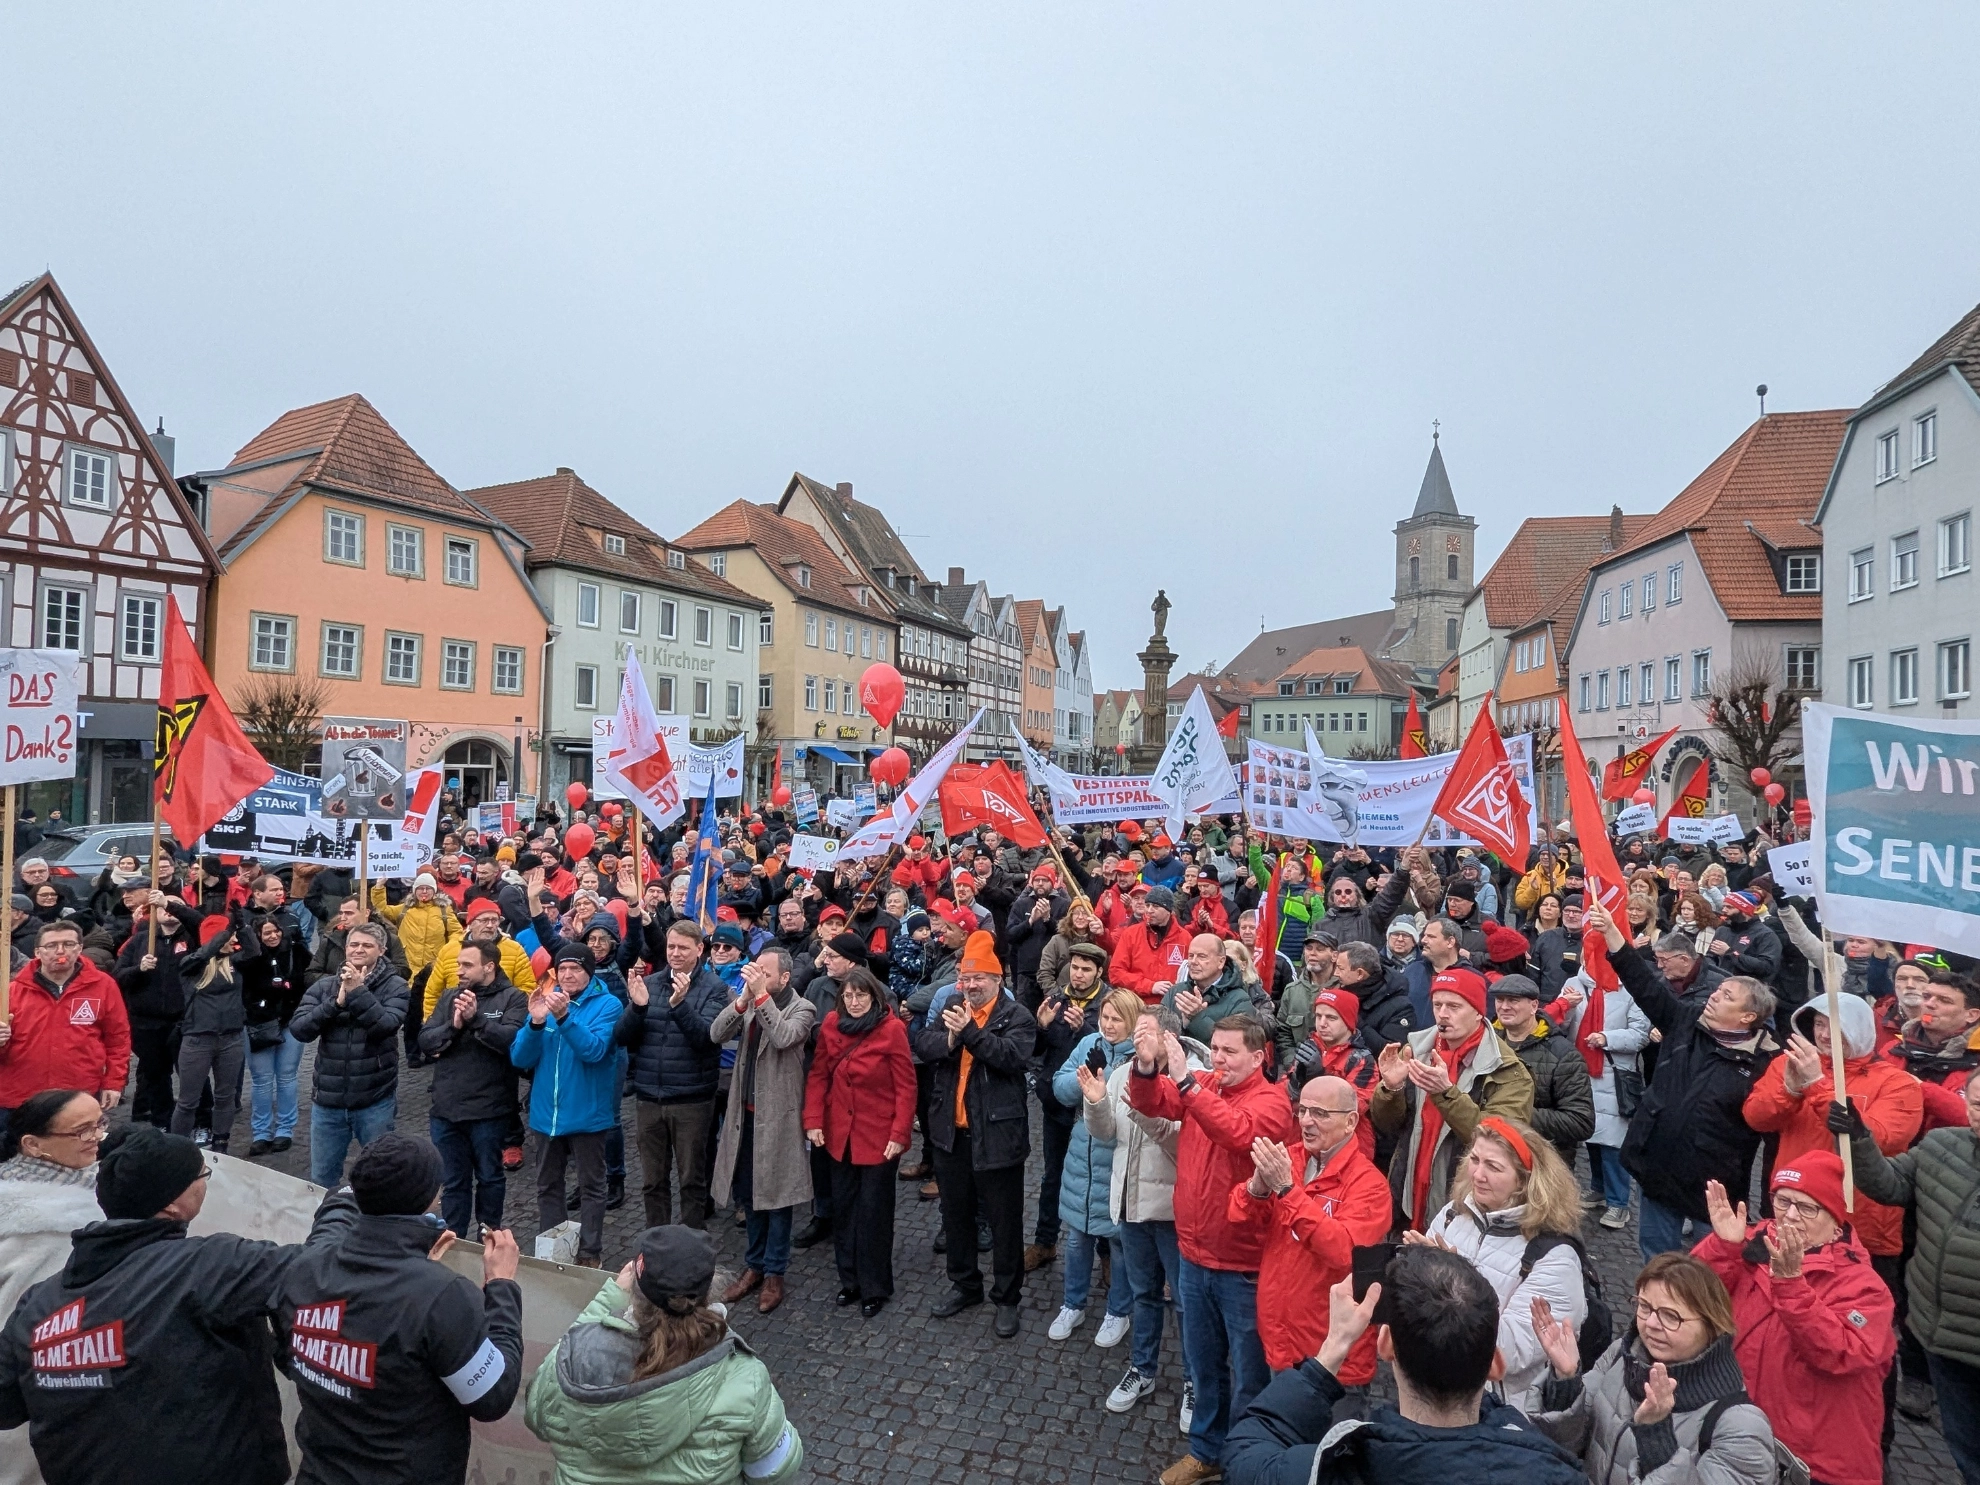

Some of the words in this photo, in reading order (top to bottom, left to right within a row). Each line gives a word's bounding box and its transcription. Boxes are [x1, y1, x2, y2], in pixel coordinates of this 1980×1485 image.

[615, 641, 647, 664] Krl
[653, 646, 715, 672] Kirchner
[9, 672, 57, 702] DAS
[5, 714, 73, 763] Dank?
[1865, 740, 1980, 795] Wir
[270, 774, 323, 789] EINSA
[1072, 779, 1150, 791] VESTIEREN
[254, 797, 298, 811] STARK
[1085, 806, 1119, 814] INNOVATIVE
[1121, 803, 1170, 812] INDUSTRIEPOLITI
[1357, 813, 1400, 821] SIEMENS
[213, 824, 246, 834] SKF
[1680, 833, 1700, 841] Valeo!
[368, 852, 379, 860] So
[381, 851, 405, 860] nicht,
[373, 863, 400, 872] Valeo!
[1785, 861, 1800, 871] So
[34, 1304, 80, 1343] TEAM
[296, 1305, 340, 1331] TEAM
[33, 1349, 46, 1367] IG
[46, 1328, 122, 1367] METALL
[292, 1332, 304, 1353] IG
[304, 1337, 371, 1383] METALL
[467, 1348, 496, 1386] ORDNER
[36, 1372, 104, 1388] Schweinfurt
[293, 1355, 352, 1399] Schweinfurt
